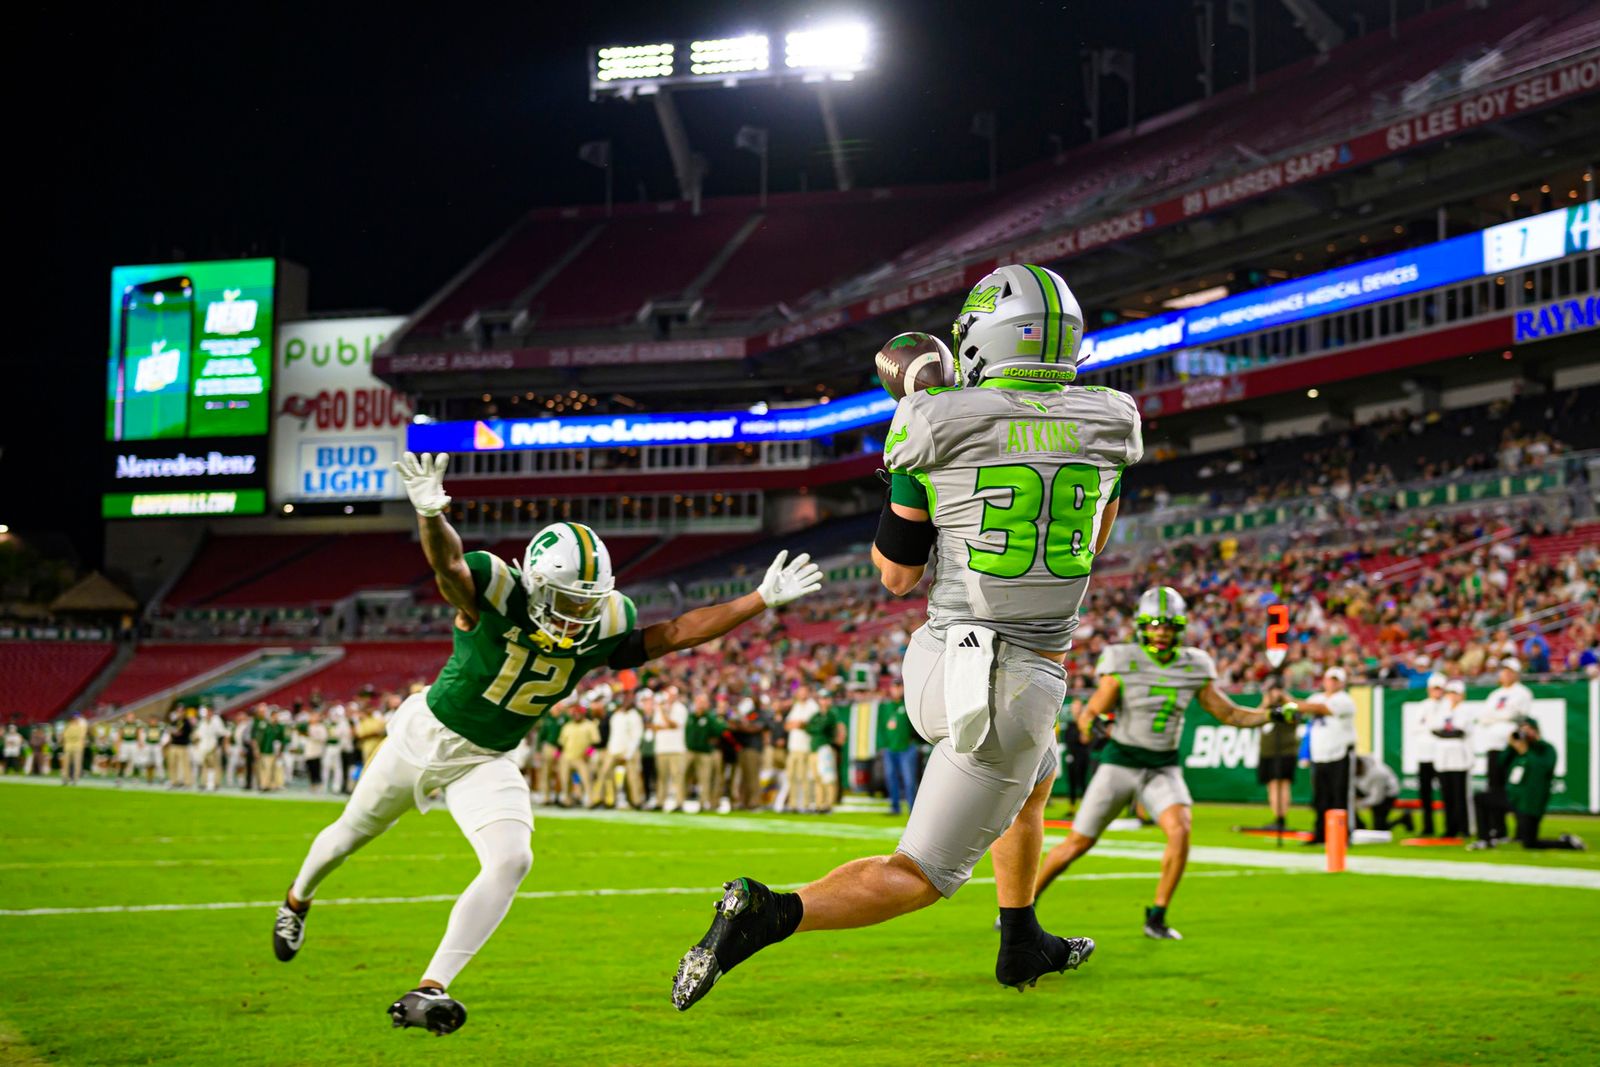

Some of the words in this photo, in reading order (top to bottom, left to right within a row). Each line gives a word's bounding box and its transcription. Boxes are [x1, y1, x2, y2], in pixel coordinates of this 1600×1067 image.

[1386, 124, 1412, 149] 63
[1415, 103, 1456, 141] LEE
[1461, 91, 1510, 125] ROY
[1514, 60, 1600, 109] SELMO
[1285, 146, 1336, 184] SAPP
[1077, 210, 1144, 250] BROOKS
[1518, 226, 1529, 259] 7
[1362, 263, 1420, 293] DEVICES
[316, 390, 348, 430] GO
[316, 445, 378, 468] BUD
[1006, 420, 1081, 454] ATKINS
[115, 451, 256, 479] Mercedes-Benz
[303, 468, 389, 493] LIGHT
[966, 463, 1101, 579] 38
[1265, 604, 1290, 651] 2
[482, 642, 576, 717] 12
[1149, 686, 1178, 733] 7
[1185, 725, 1261, 769] BRA
